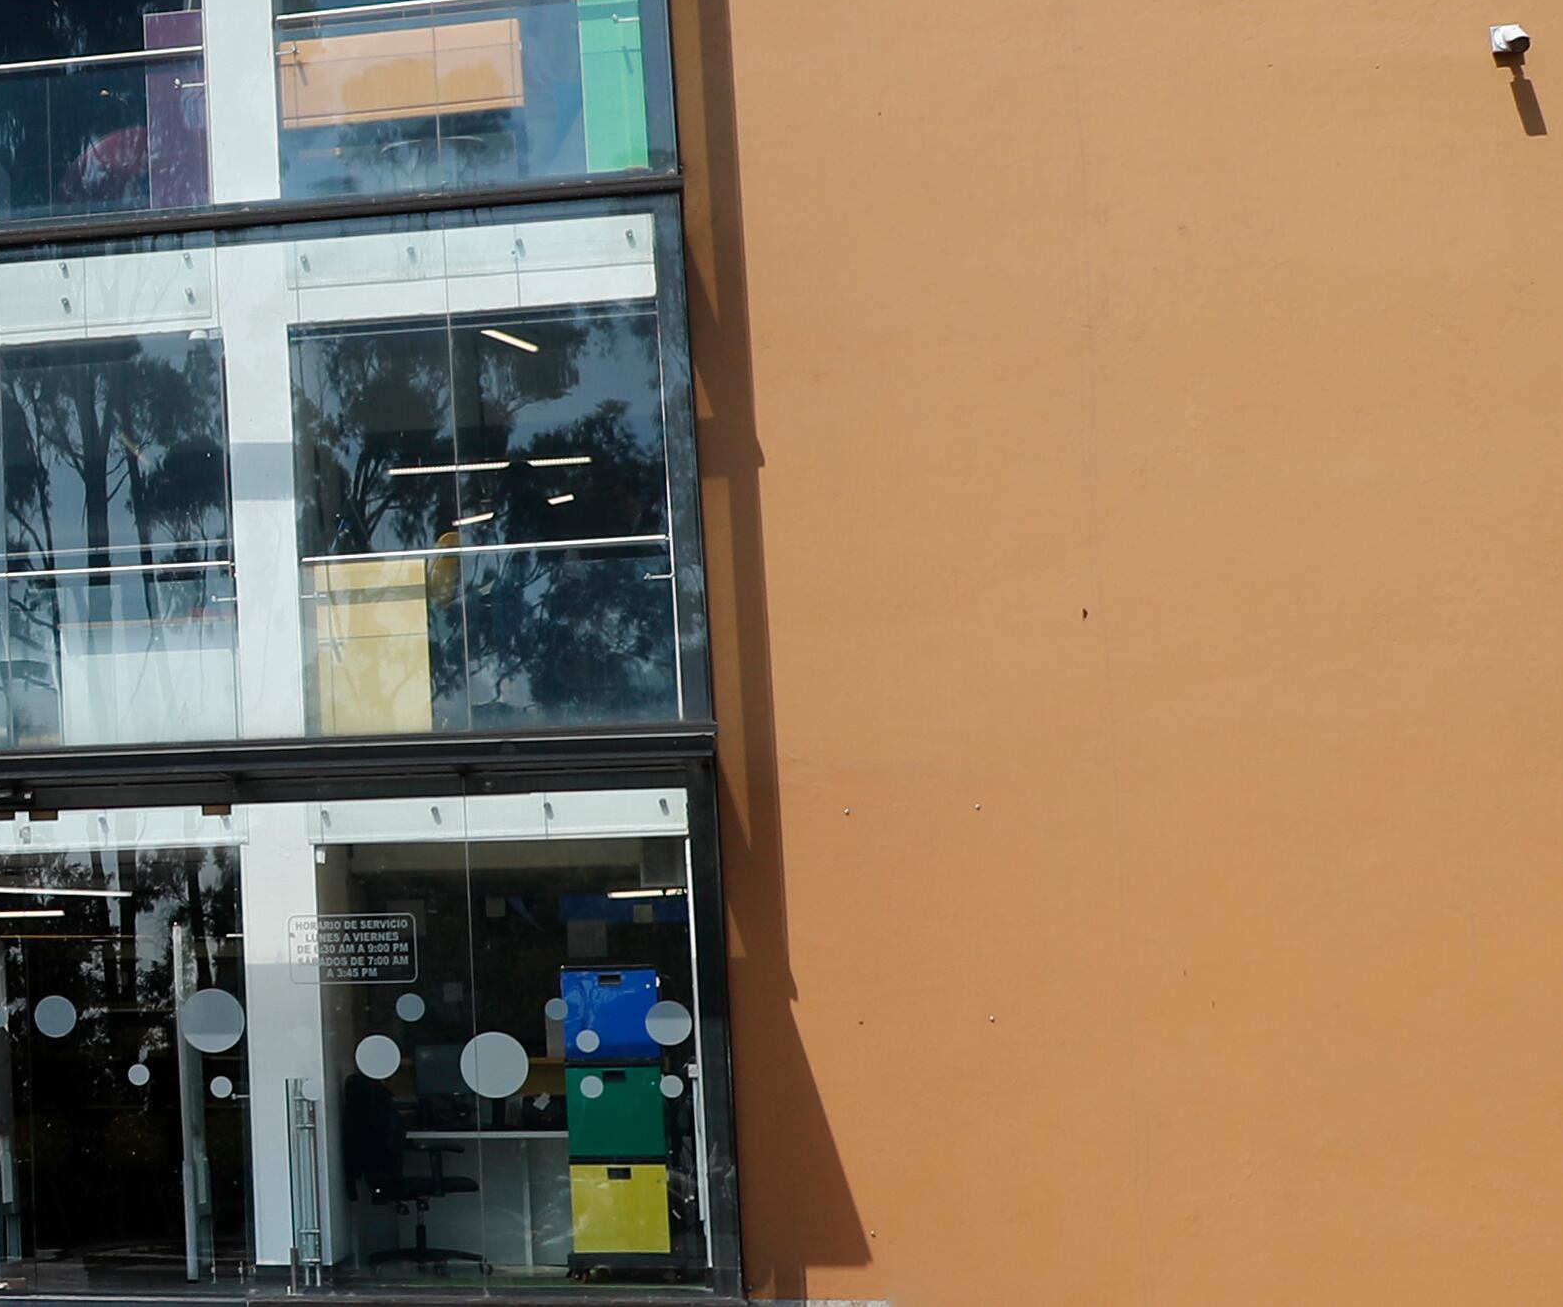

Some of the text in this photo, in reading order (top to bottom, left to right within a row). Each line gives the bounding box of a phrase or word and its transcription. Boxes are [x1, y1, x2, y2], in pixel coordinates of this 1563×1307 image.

[295, 919, 408, 931] HORARIO DE SERVICIO
[305, 932, 399, 943] LUNES A VIERNES
[338, 944, 355, 953] AM
[357, 944, 366, 953] A
[367, 943, 390, 953] 9:00
[392, 942, 409, 952] PM
[350, 956, 365, 966] DE
[367, 956, 390, 965] 7:00
[392, 955, 409, 965] AM
[326, 967, 378, 978] A 3:45 PM
